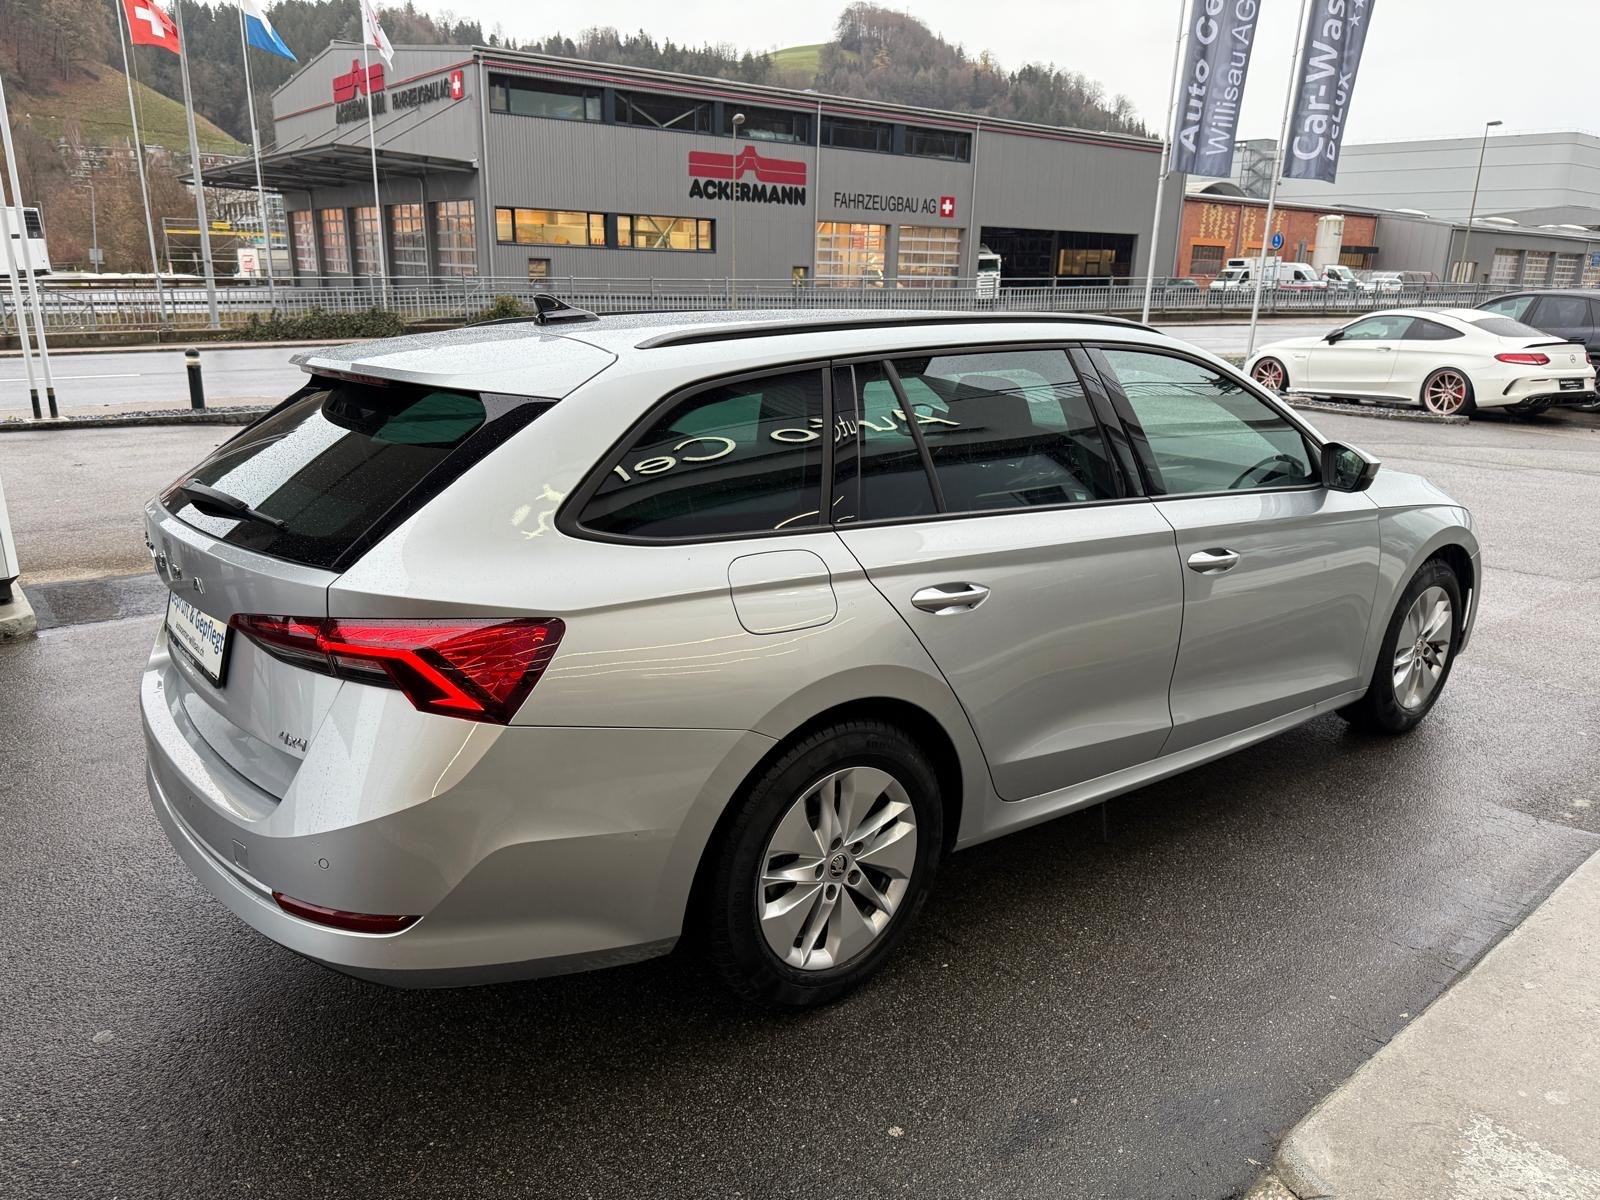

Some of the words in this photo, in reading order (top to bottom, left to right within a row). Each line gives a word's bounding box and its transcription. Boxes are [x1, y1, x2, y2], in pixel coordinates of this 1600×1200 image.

[1180, 58, 1210, 153] Auto
[1206, 50, 1248, 156] Willisau
[1231, 0, 1256, 46] AG
[1292, 0, 1346, 161] Car-Was
[689, 178, 806, 206] ACKERMANN
[833, 191, 919, 213] FAHRZEUGBAU
[921, 198, 937, 214] AG
